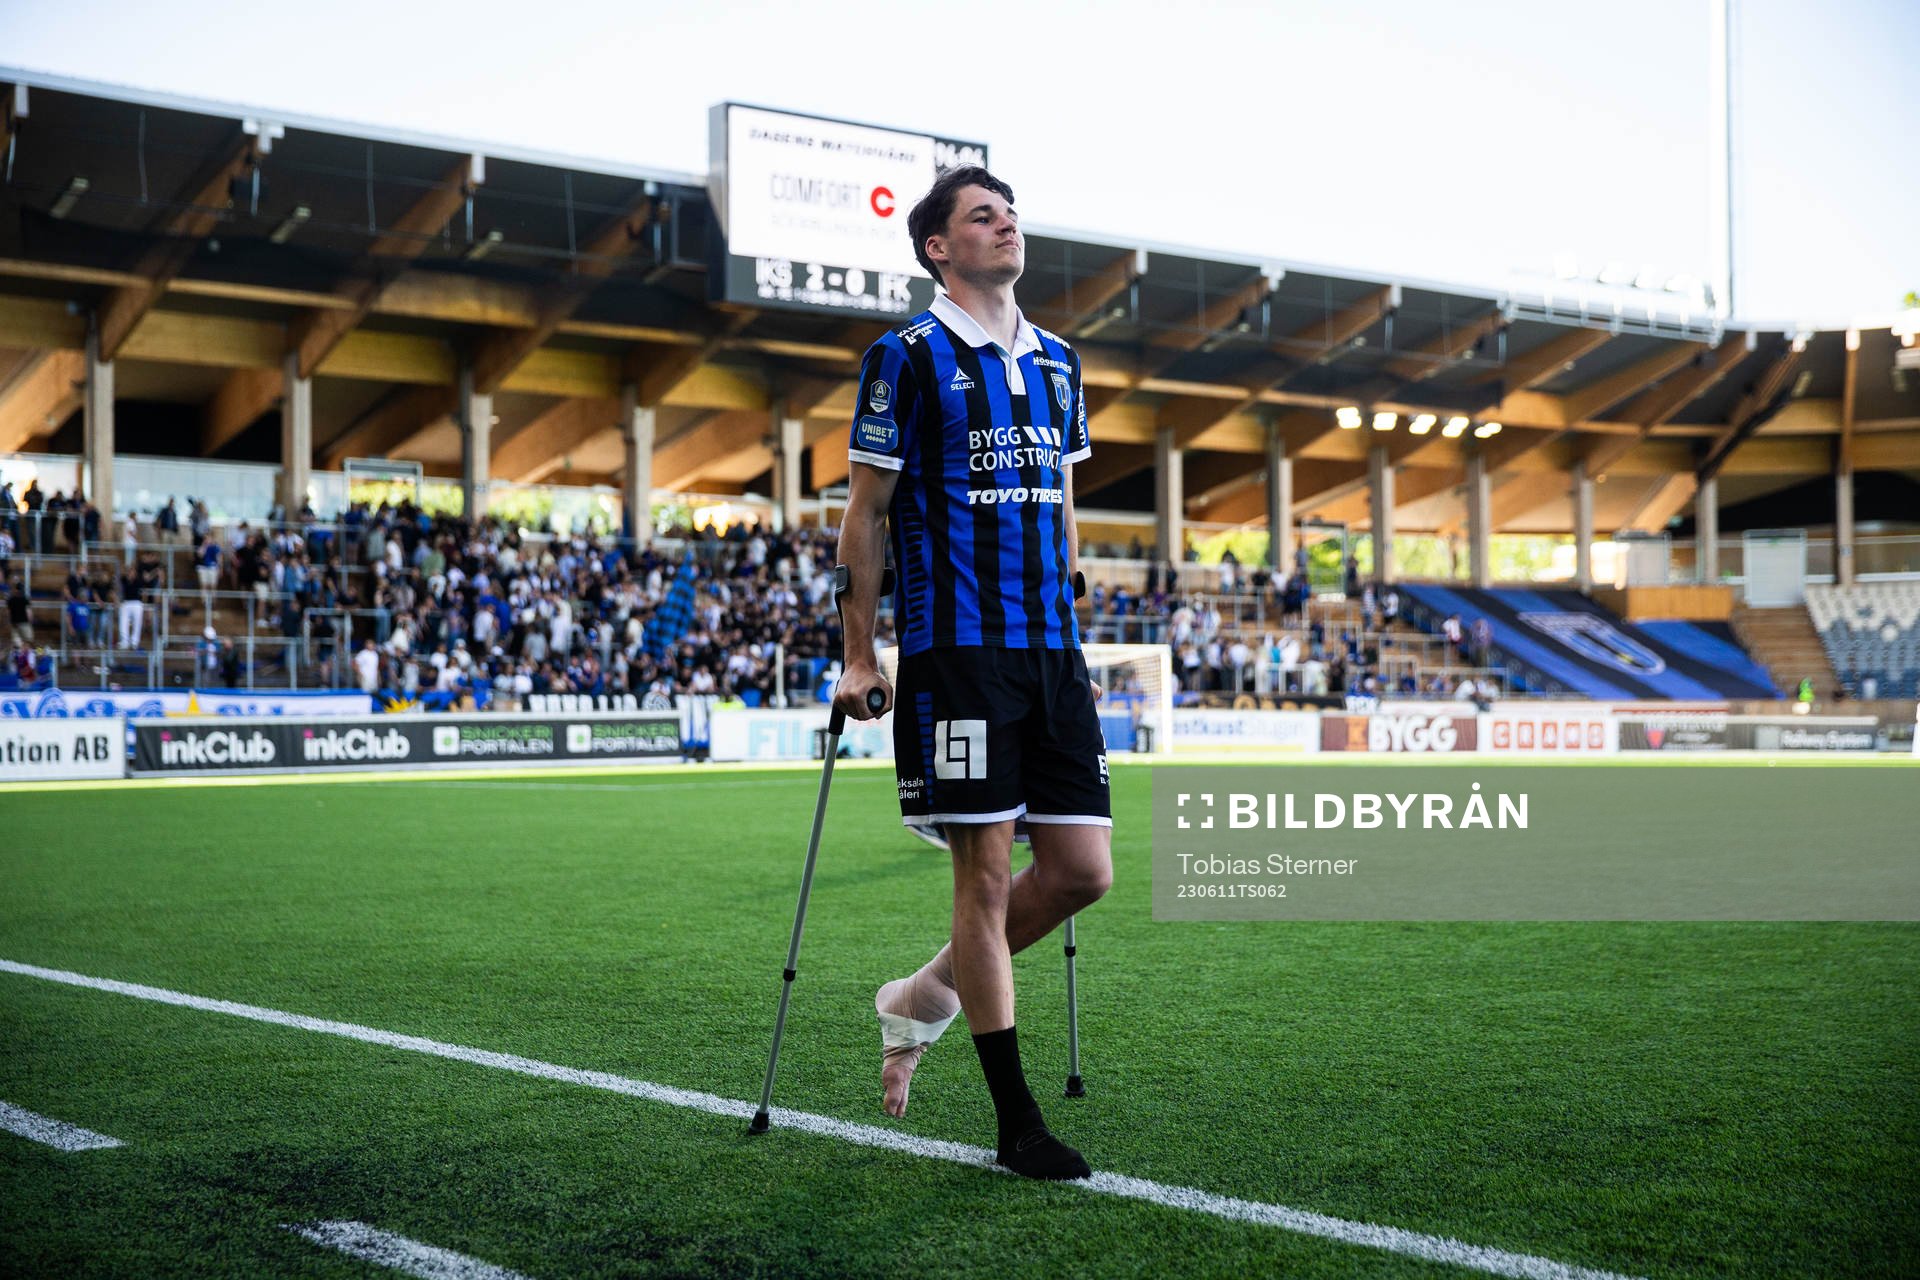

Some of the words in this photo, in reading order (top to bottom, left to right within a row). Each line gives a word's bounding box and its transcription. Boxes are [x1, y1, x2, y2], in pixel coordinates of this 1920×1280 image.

[950, 382, 975, 391] SELECT
[861, 423, 895, 438] UNIBET
[968, 427, 1021, 450] BYGG
[969, 448, 1061, 472] CONSTRUCT
[967, 487, 1029, 504] TOYO
[1031, 488, 1063, 504] TIRES
[592, 736, 679, 753] PORTALEN
[1368, 714, 1457, 752] BYGG
[73, 736, 109, 761] AB
[160, 730, 276, 765] inkClub
[303, 728, 410, 762] inkClub
[460, 739, 554, 755] PORTALEN
